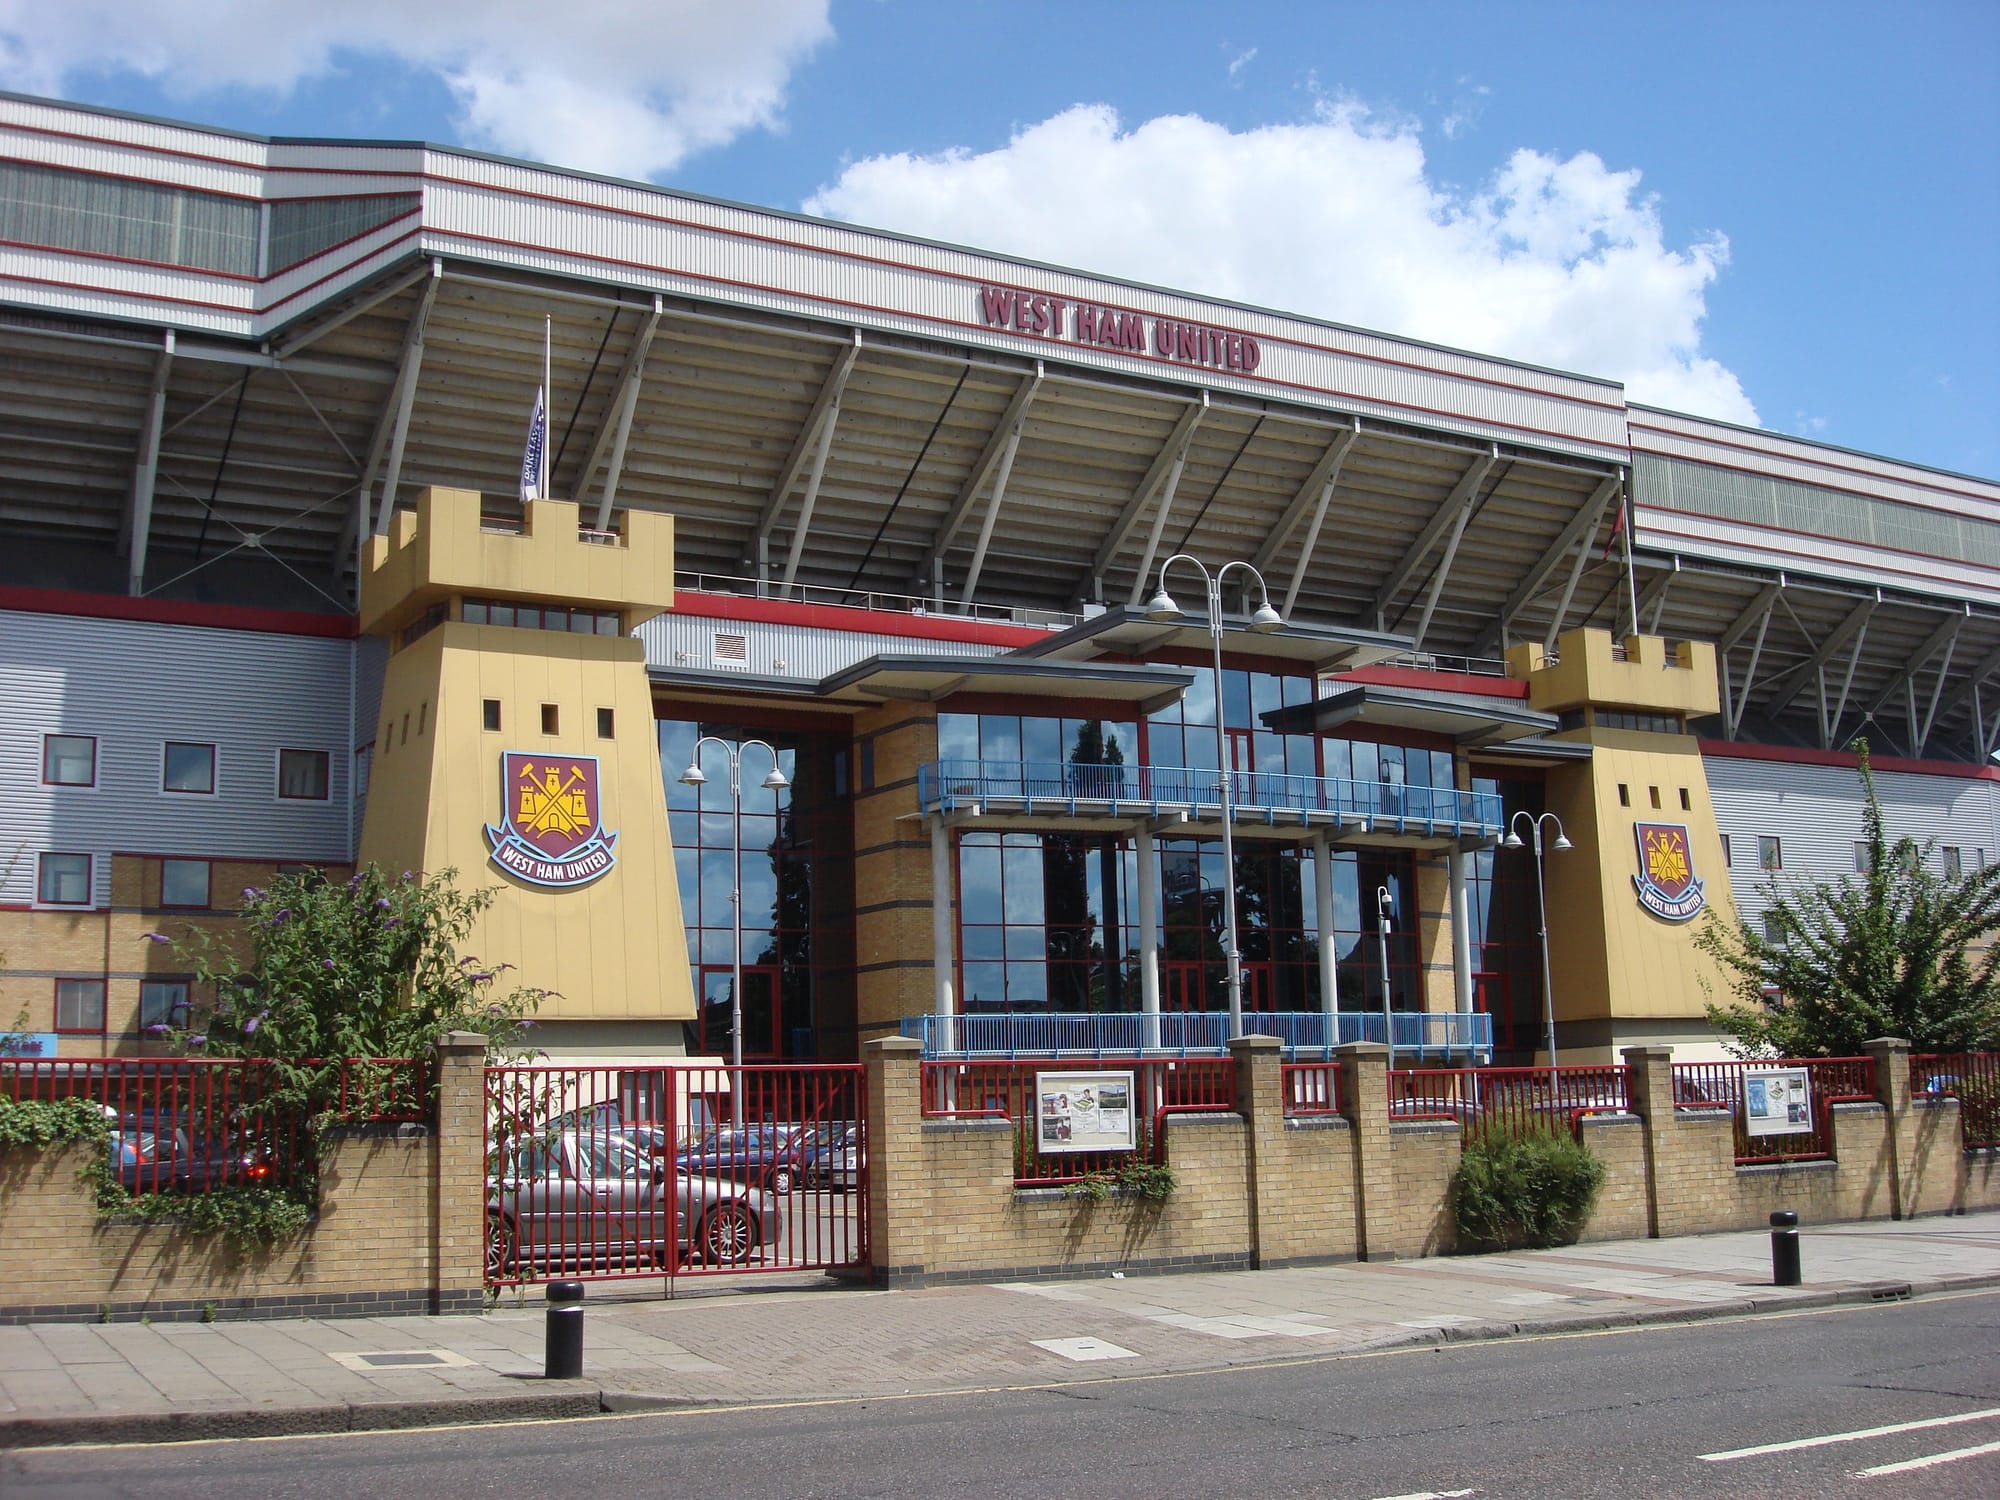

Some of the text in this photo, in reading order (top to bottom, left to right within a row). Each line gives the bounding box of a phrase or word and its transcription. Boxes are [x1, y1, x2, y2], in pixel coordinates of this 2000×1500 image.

[981, 285, 1261, 371] WEST HAM UNITED
[502, 846, 607, 880] WEST HAM UNITED
[1645, 890, 1701, 915] WEST HAM UNITED
